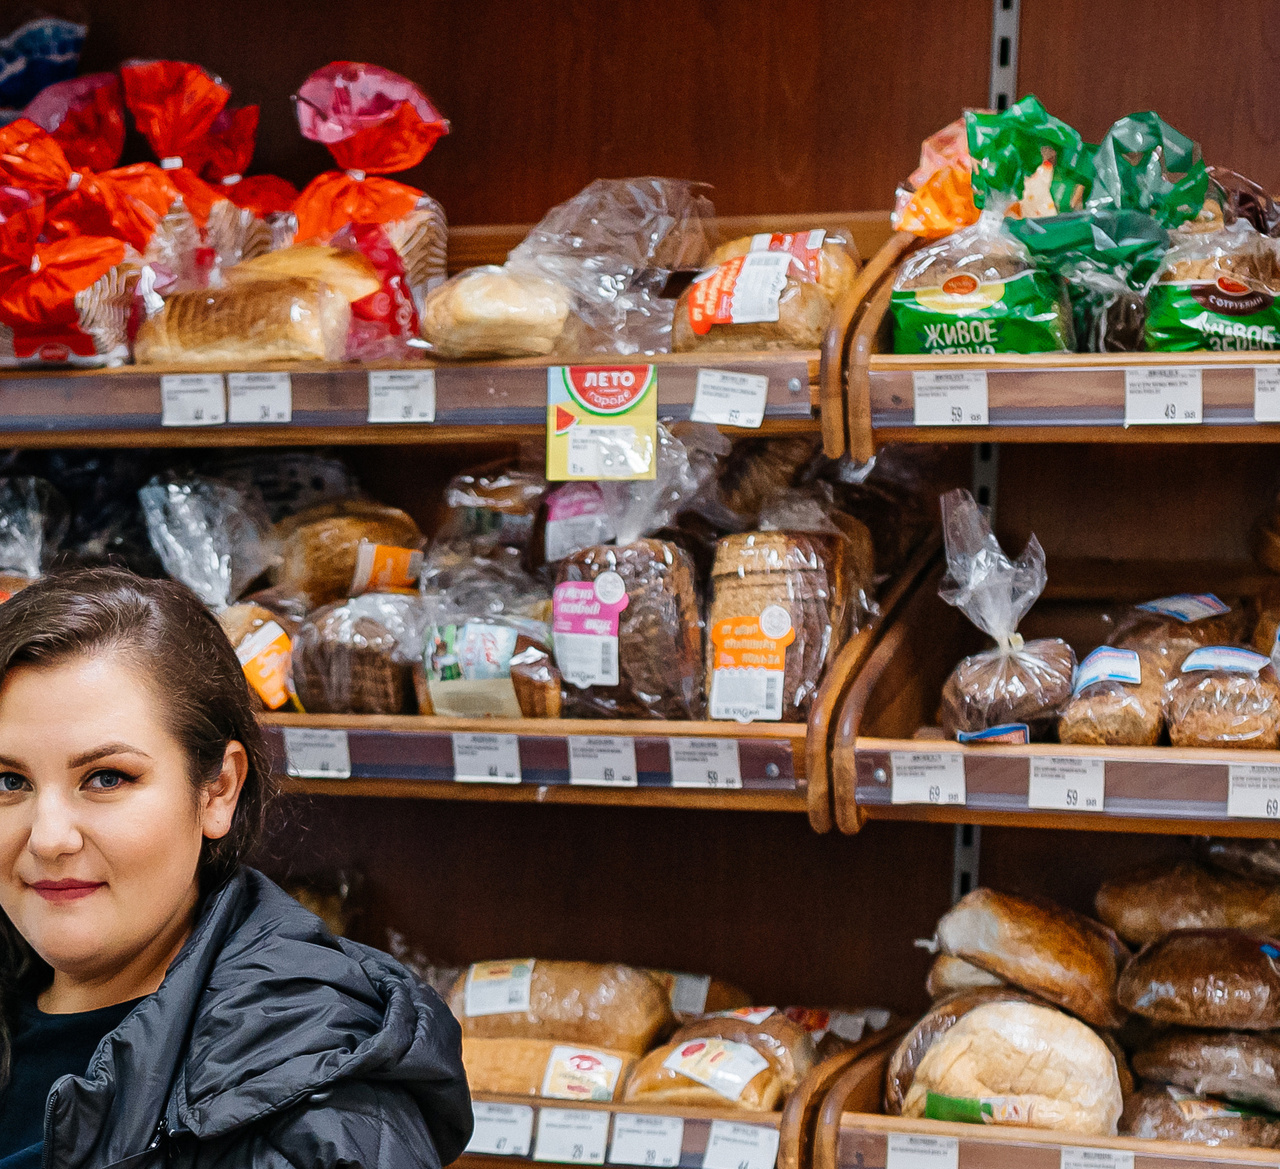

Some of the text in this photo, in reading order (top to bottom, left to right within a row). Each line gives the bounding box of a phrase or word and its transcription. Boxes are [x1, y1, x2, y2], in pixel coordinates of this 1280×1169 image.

[924, 321, 999, 347] ЖИВОЕ
[583, 371, 635, 388] ЛЕТО
[1164, 404, 1176, 419] 49
[1066, 789, 1078, 806] 59
